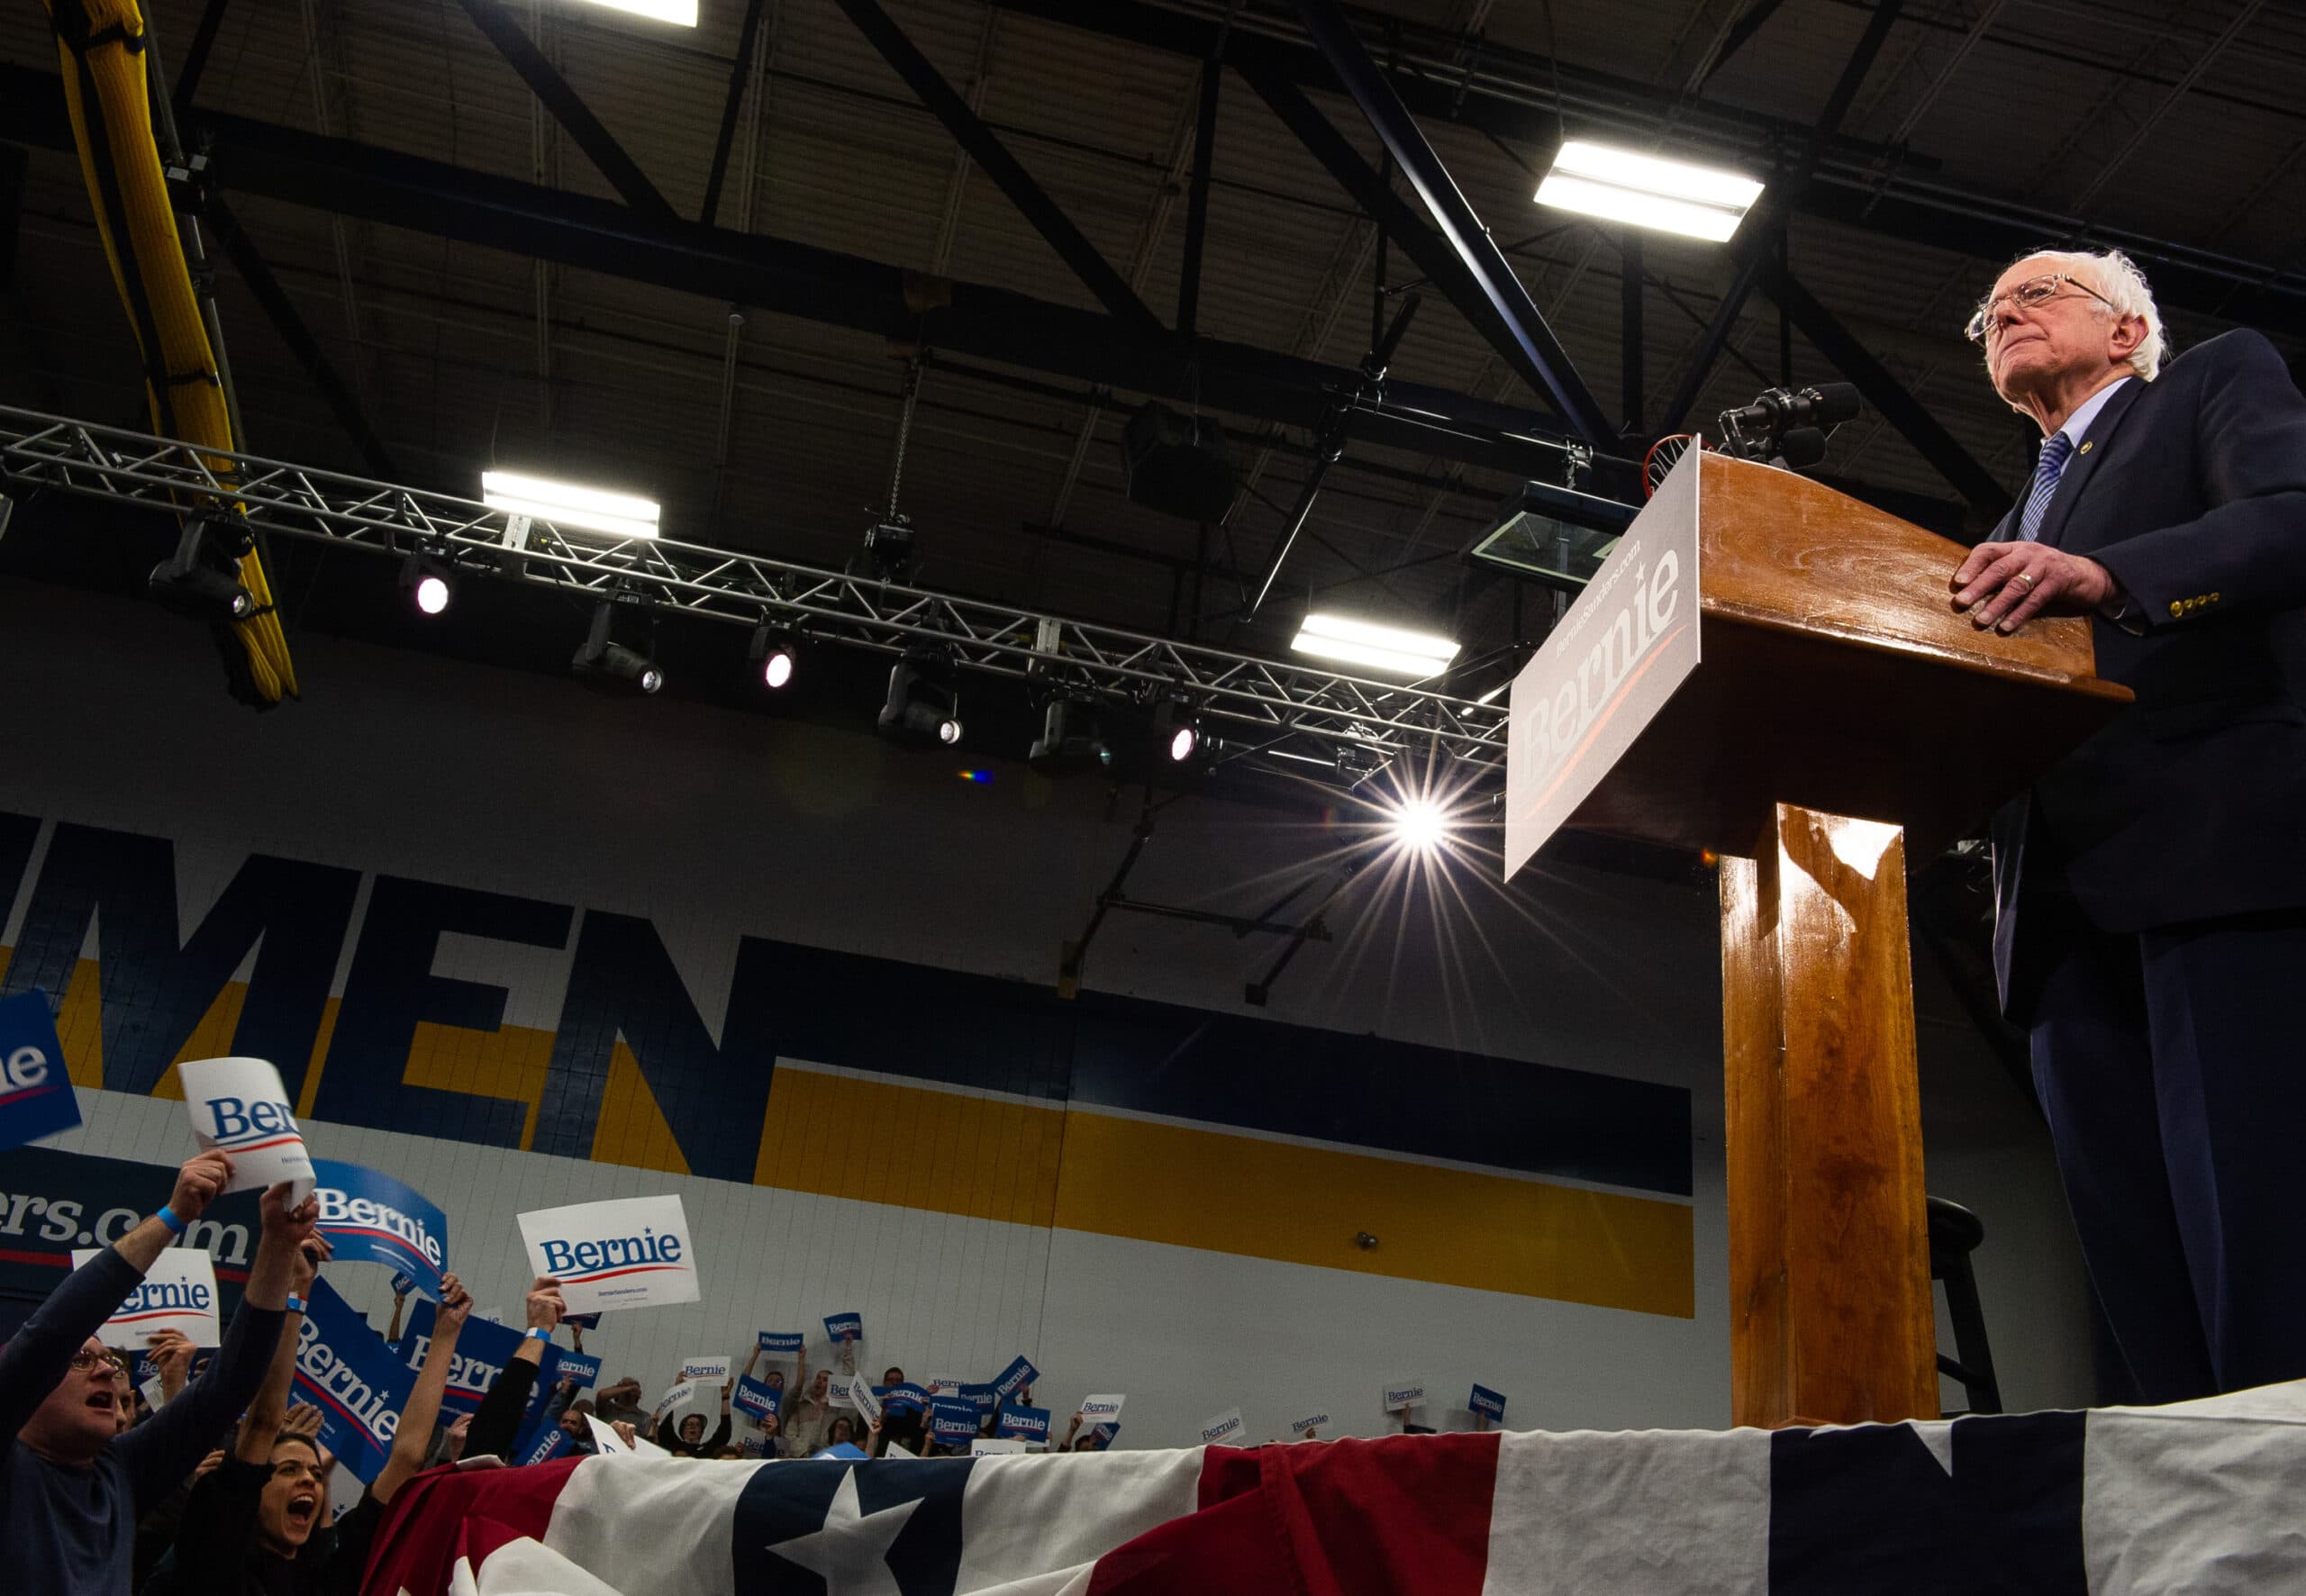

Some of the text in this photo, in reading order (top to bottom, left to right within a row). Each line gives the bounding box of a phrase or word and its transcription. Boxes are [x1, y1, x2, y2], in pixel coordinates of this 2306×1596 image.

[1521, 549, 1679, 784] Bernie
[207, 1097, 299, 1139] Ber
[316, 1187, 441, 1267] Bernie
[540, 1226, 682, 1273] Bernie
[122, 1276, 210, 1312] ernie
[685, 1365, 726, 1376] Bernie
[996, 1364, 1031, 1396] Bernie
[738, 1383, 776, 1412] Bernie
[1083, 1401, 1119, 1412] Bernie
[1387, 1386, 1424, 1402] Bernie
[1473, 1391, 1503, 1414] Bernie
[934, 1417, 978, 1435] Bernie
[1002, 1411, 1046, 1431] Bernie
[1202, 1417, 1240, 1441] Bernie
[1292, 1414, 1329, 1433] Bernie
[526, 1430, 562, 1466] ernie
